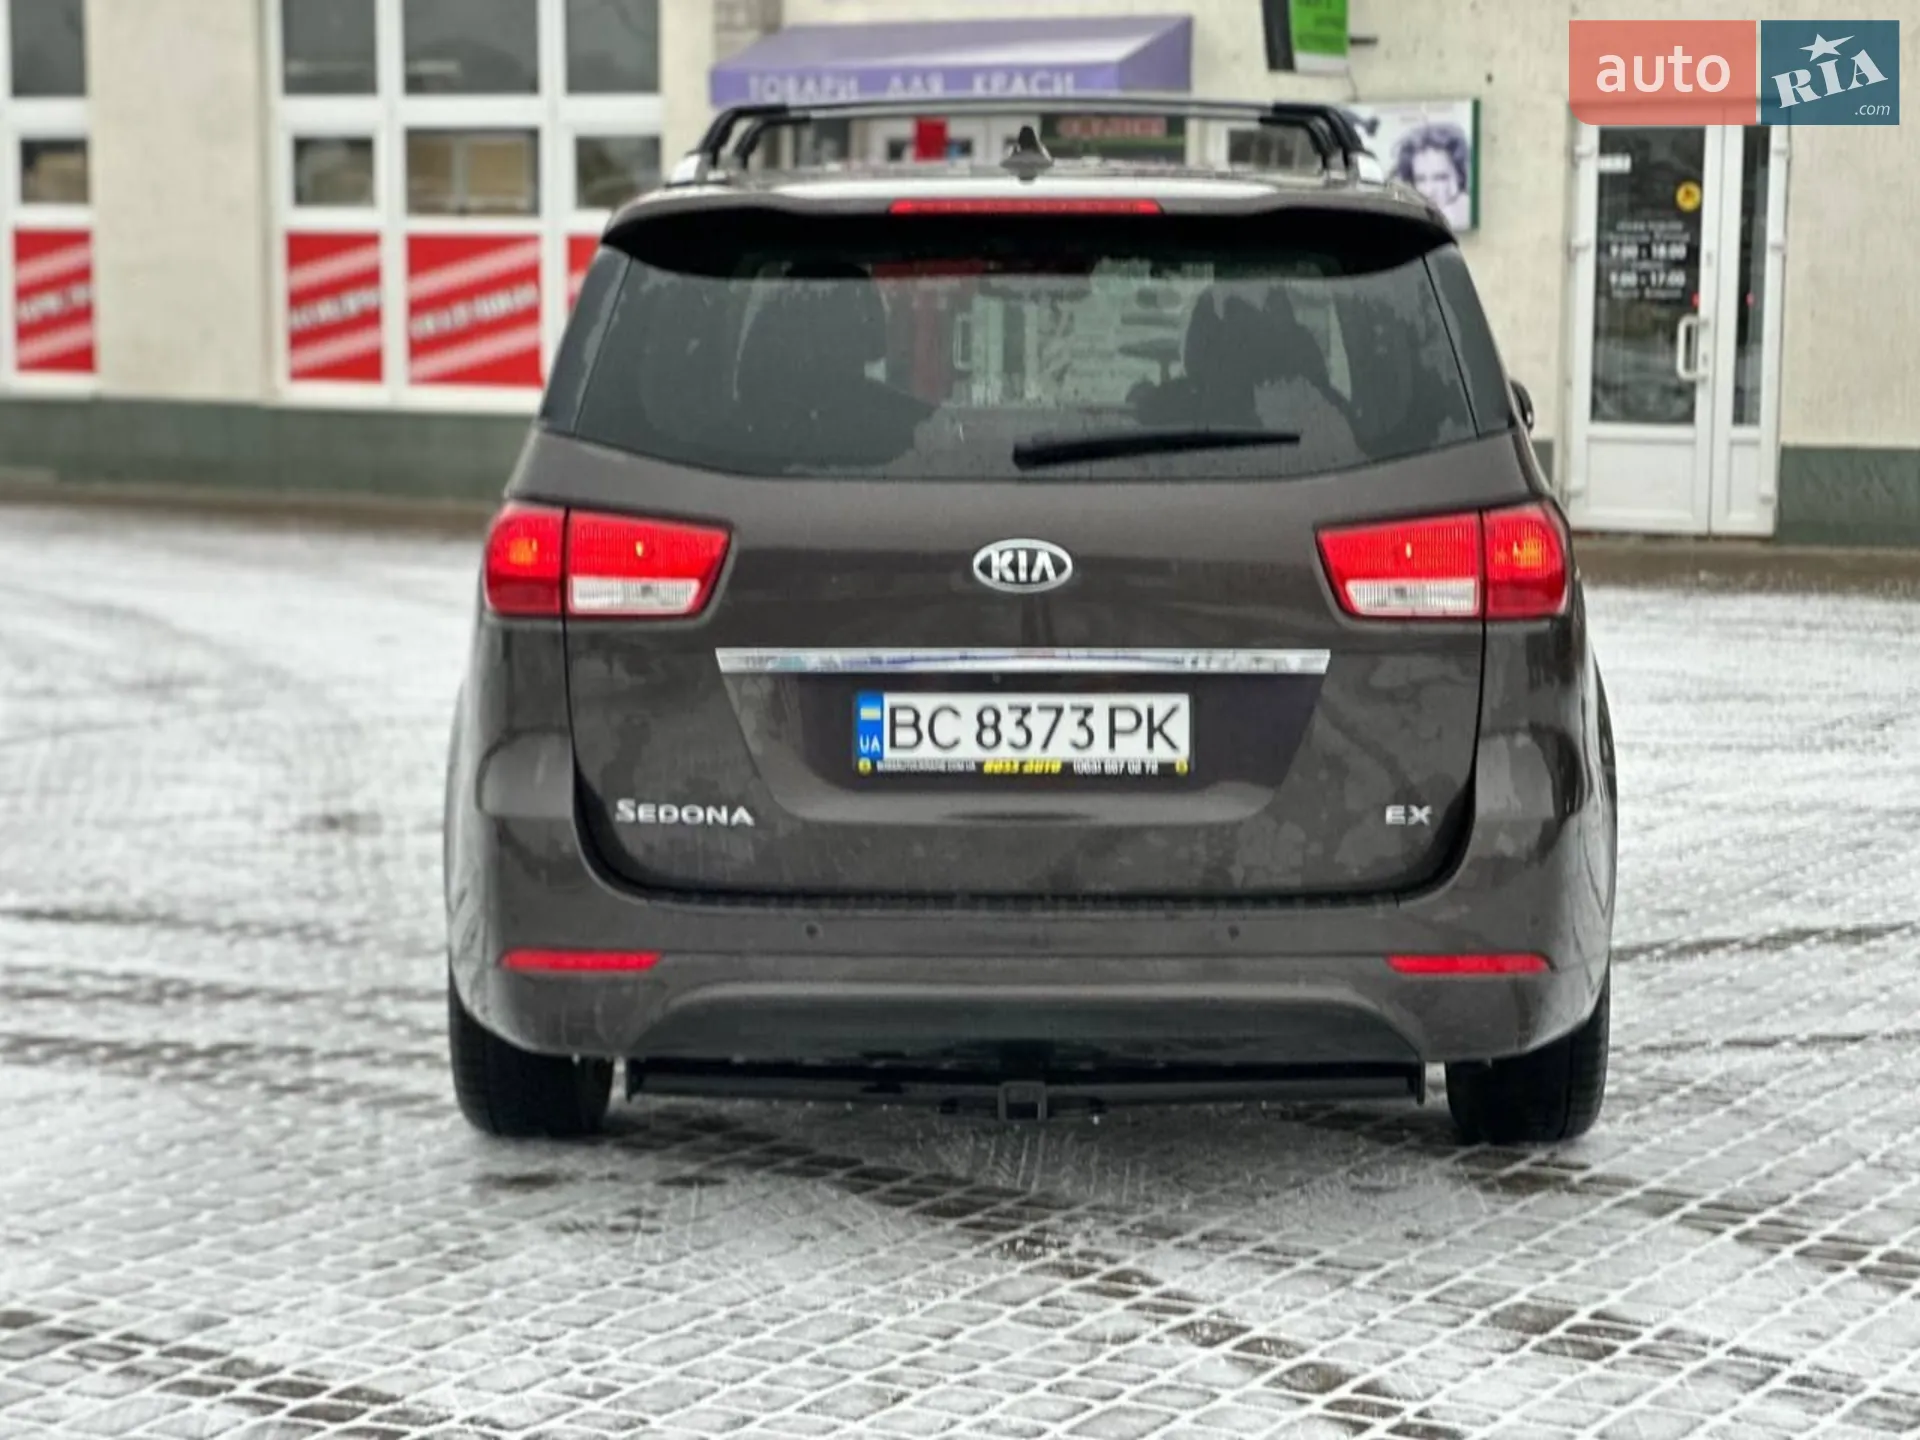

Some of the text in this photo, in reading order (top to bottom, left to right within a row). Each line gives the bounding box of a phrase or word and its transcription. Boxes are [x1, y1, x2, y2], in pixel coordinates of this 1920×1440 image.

[990, 549, 1058, 582] KIA
[888, 704, 1180, 752] BC 8373 PK
[859, 735, 881, 753] UA
[615, 798, 755, 826] SEDONA
[1385, 804, 1432, 826] EX
